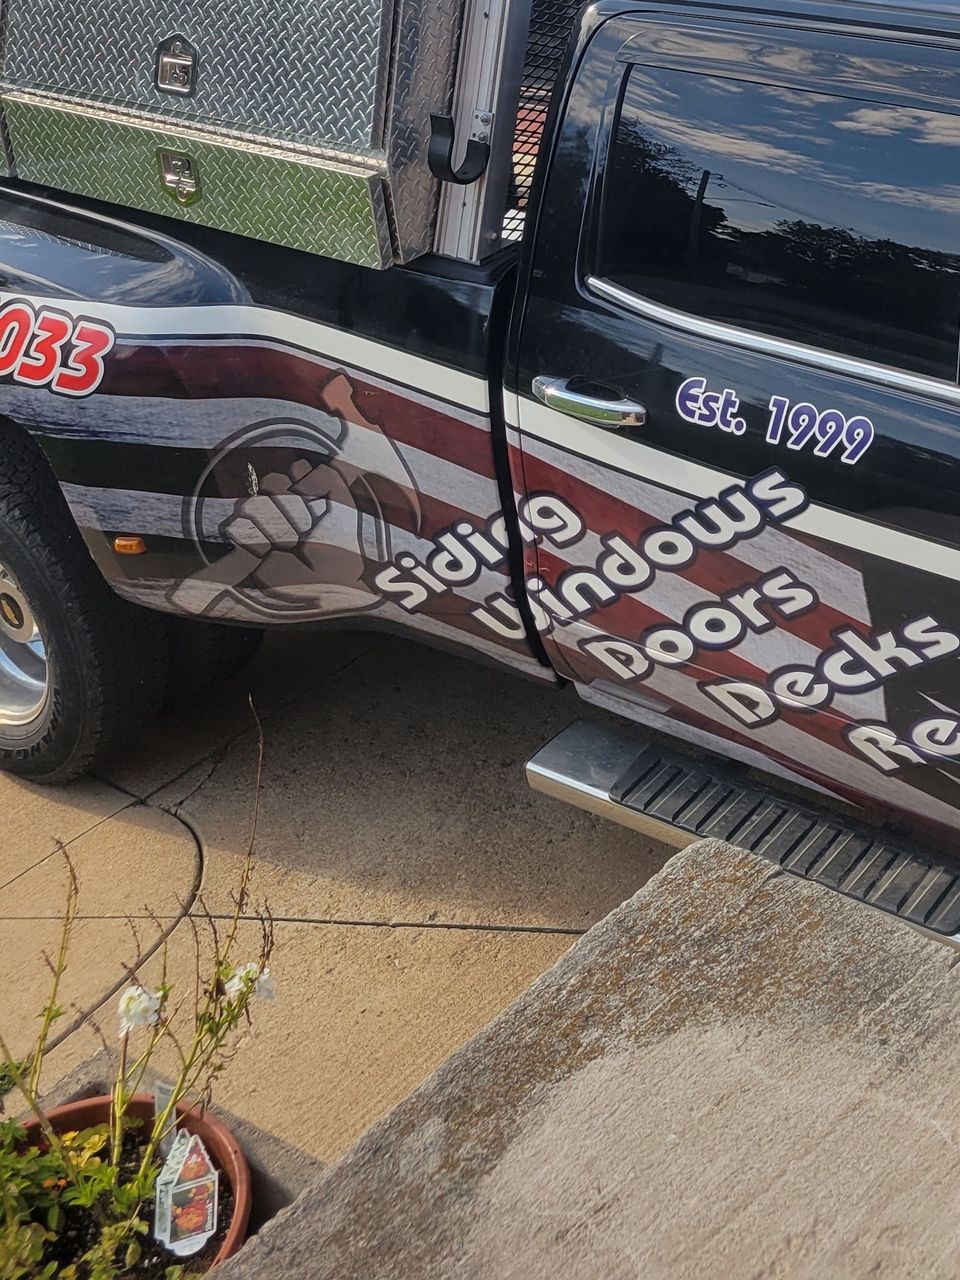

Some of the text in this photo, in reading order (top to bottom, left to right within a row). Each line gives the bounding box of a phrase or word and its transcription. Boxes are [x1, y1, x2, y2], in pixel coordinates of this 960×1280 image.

[675, 376, 874, 466] Est. 1999
[582, 572, 815, 681] Doors
[703, 615, 960, 725] Decks
